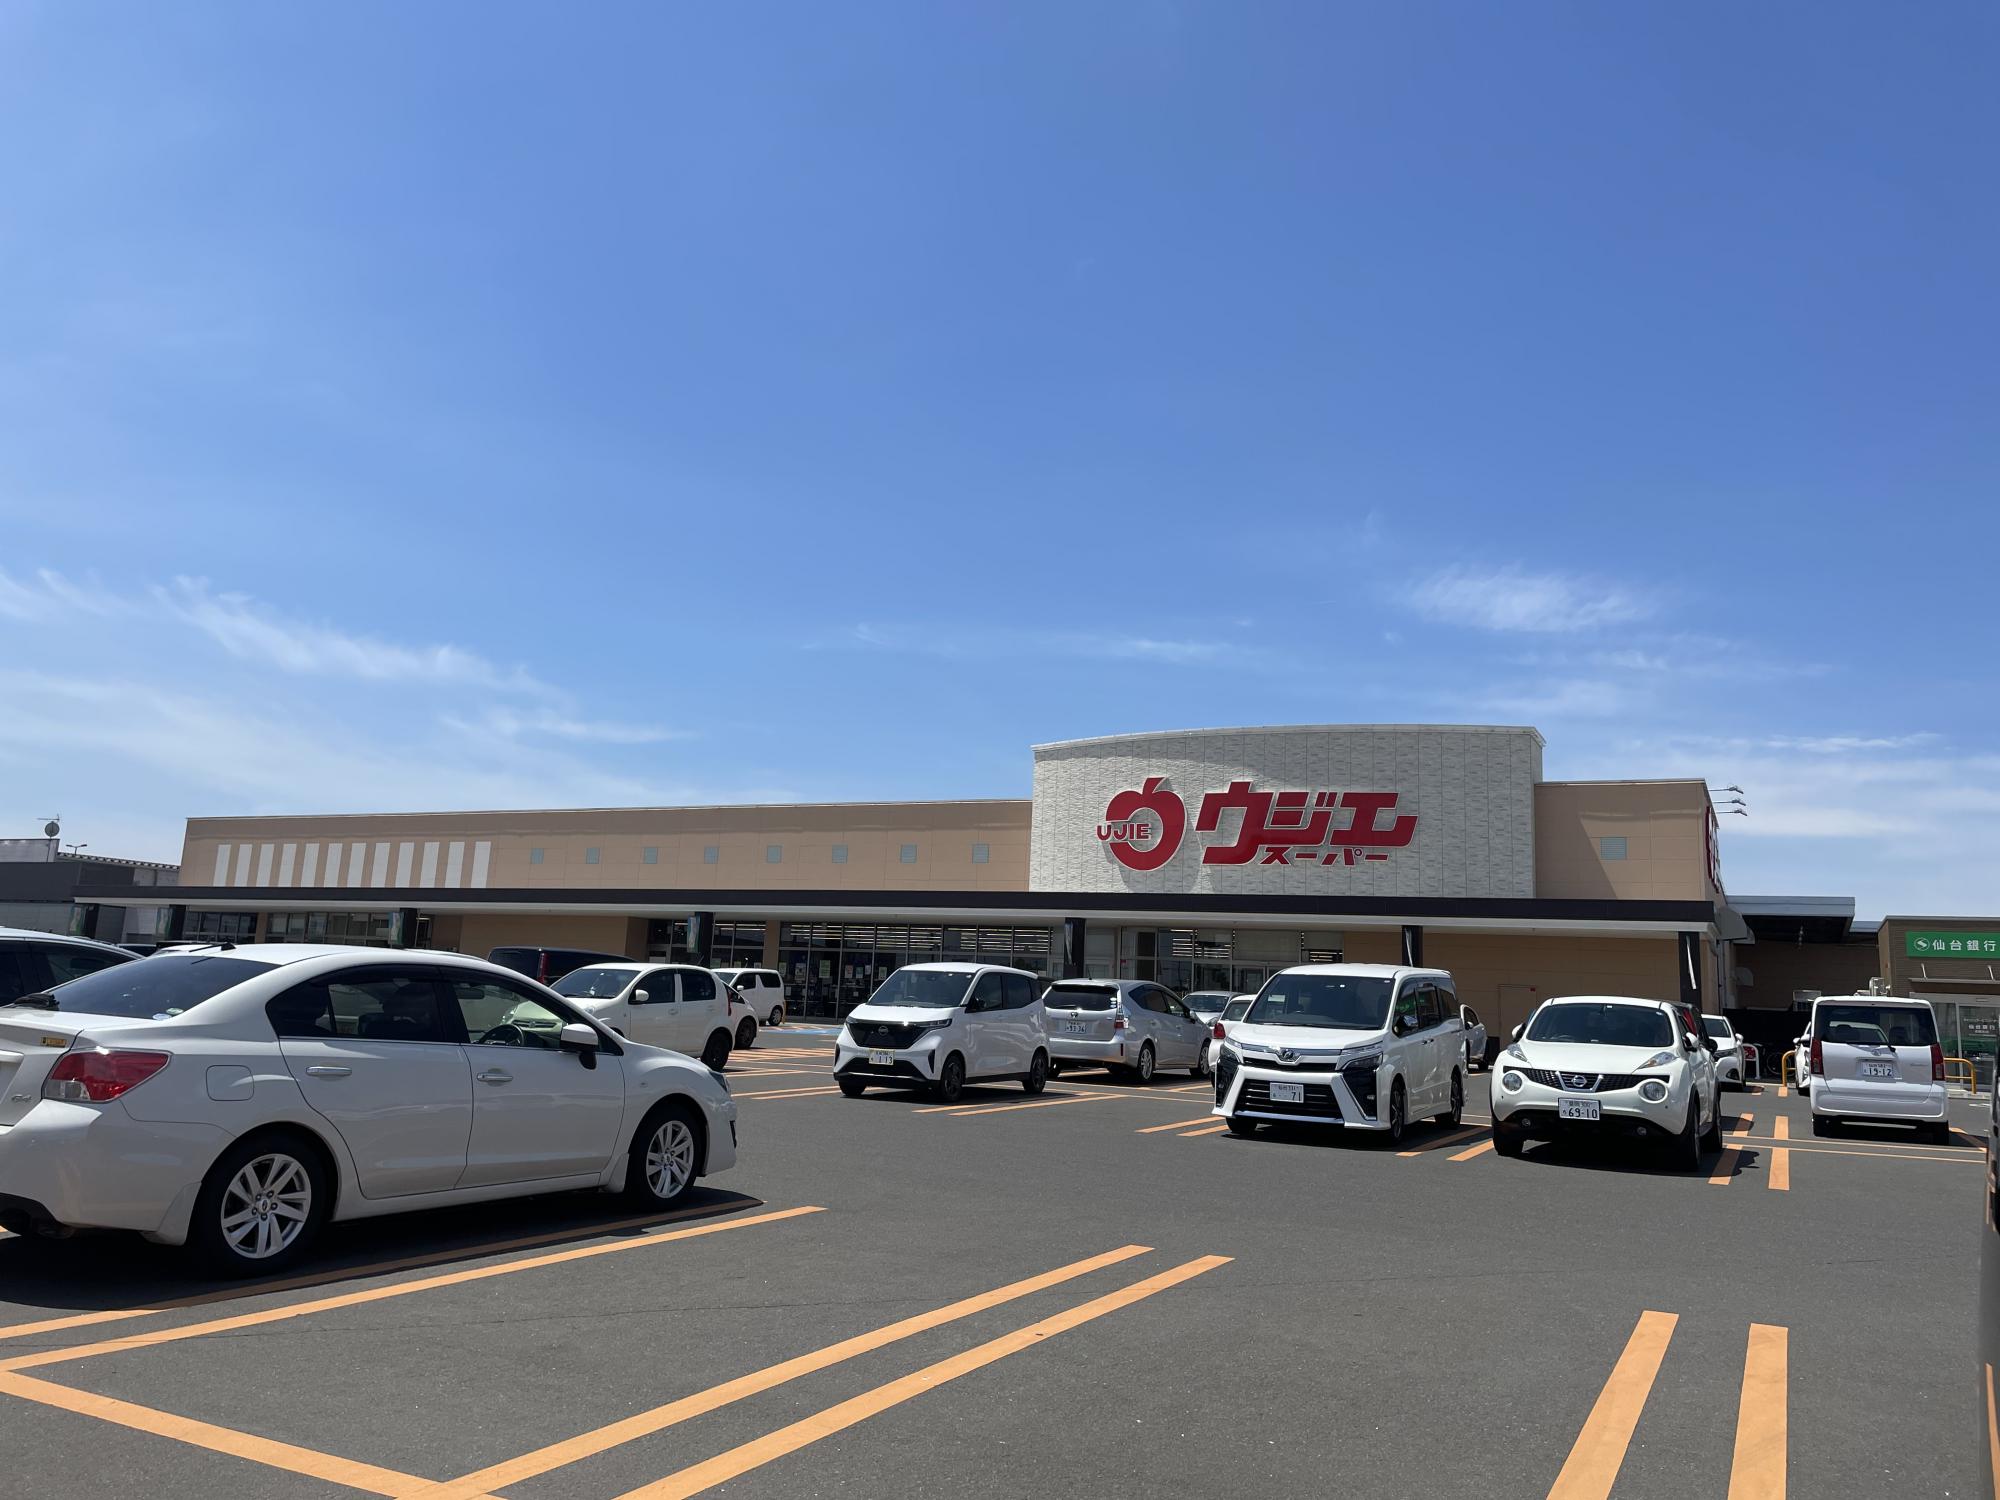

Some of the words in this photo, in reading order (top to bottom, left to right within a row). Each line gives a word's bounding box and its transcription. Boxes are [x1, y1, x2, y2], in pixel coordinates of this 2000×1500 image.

[1096, 823, 1151, 842] UJIE
[1195, 780, 1419, 866] ウジエ
[1258, 847, 1389, 867] スーパー
[1932, 939, 1996, 952] 仙台銀行
[1568, 1107, 1598, 1119] 69-10
